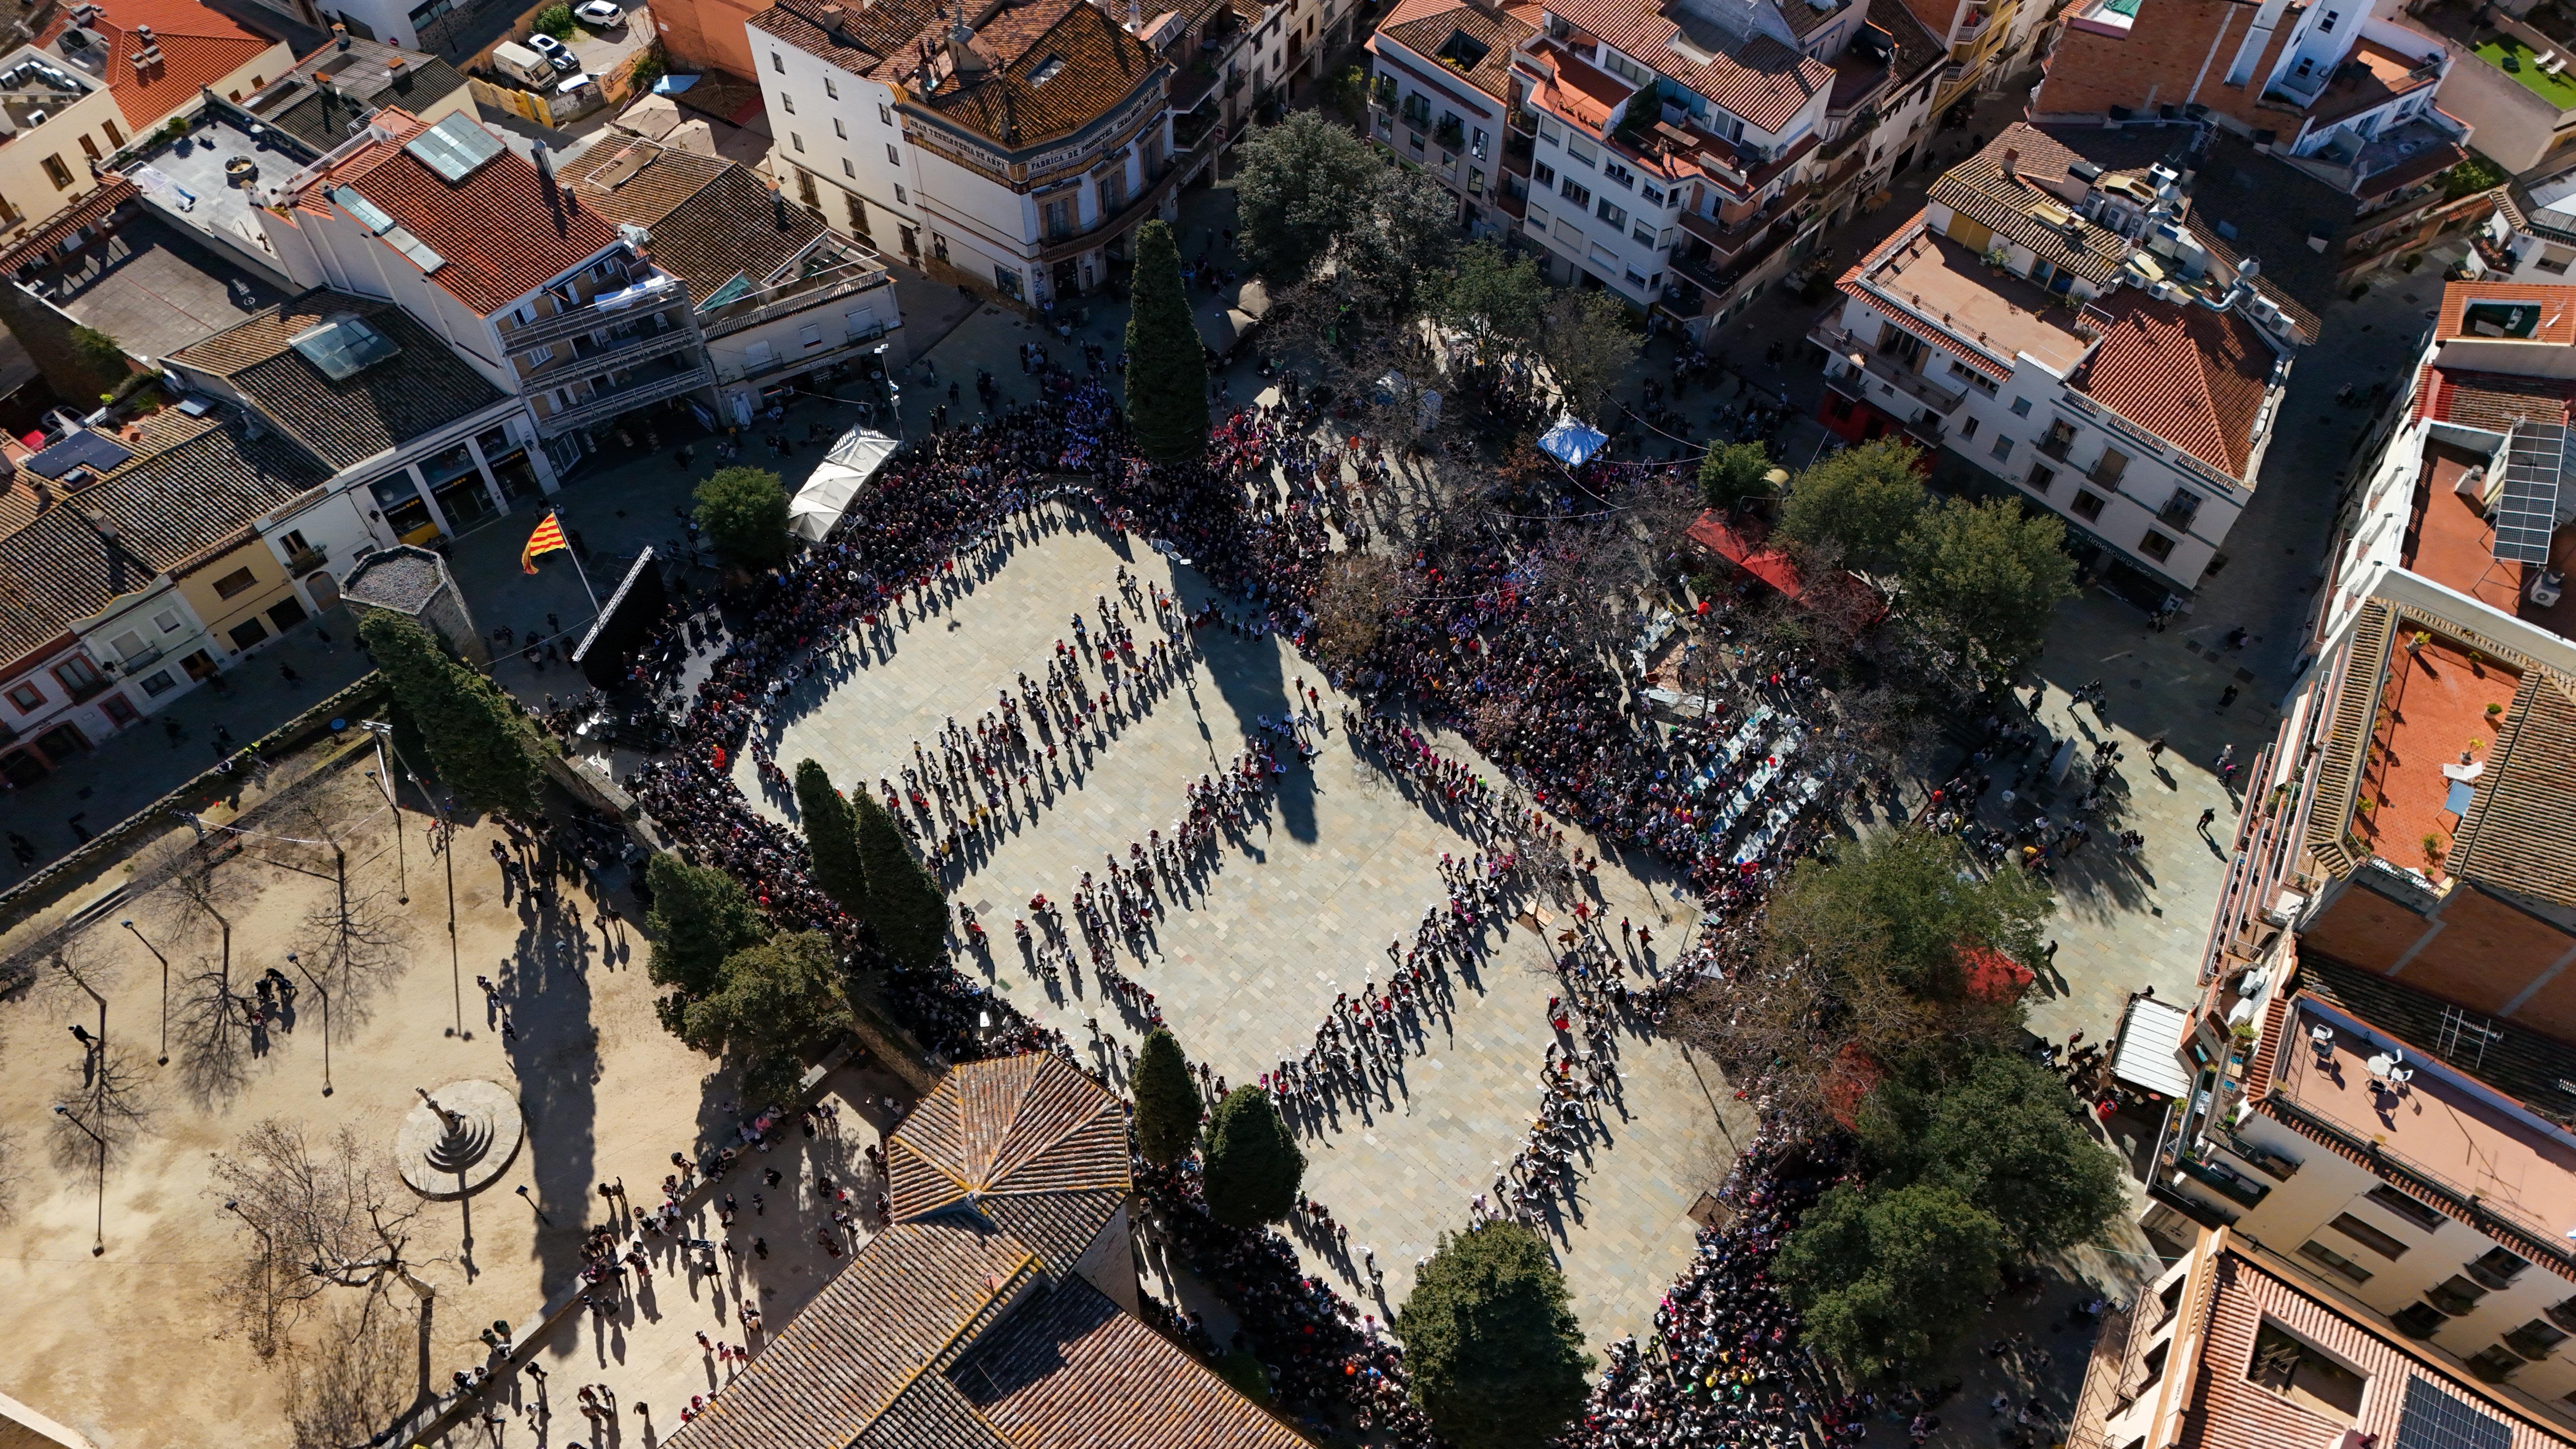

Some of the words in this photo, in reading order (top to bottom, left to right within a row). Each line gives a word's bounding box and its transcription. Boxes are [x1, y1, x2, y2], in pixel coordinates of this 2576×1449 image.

[910, 120, 927, 133] GRAN
[976, 150, 985, 160] DE
[987, 156, 1005, 170] ARPI
[1031, 155, 1064, 170] FABRICA
[1068, 150, 1078, 158] DE
[1082, 127, 1113, 153] PRODUCTES
[492, 457, 511, 468] Abacus
[435, 484, 454, 495] Abacus
[387, 505, 407, 516] Abacus
[2086, 534, 2133, 567] Timesburg
